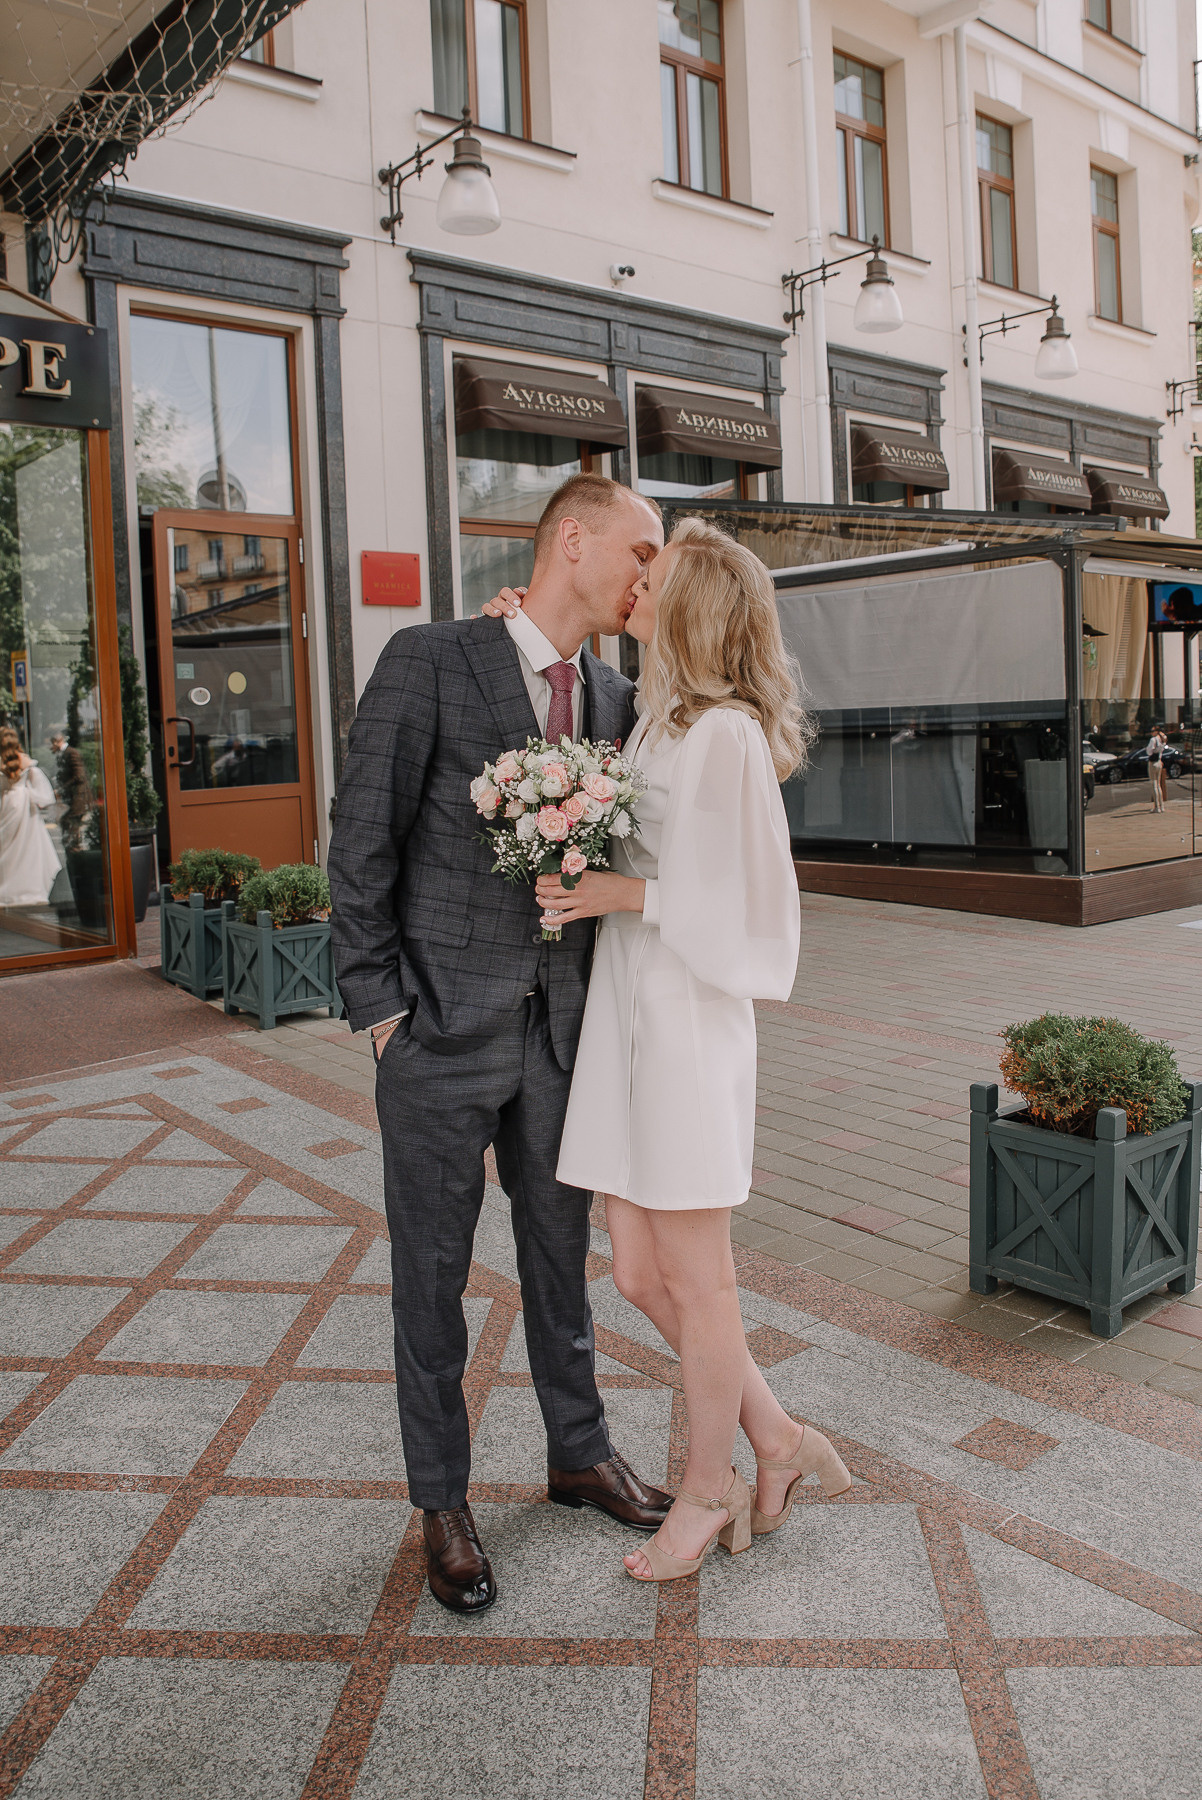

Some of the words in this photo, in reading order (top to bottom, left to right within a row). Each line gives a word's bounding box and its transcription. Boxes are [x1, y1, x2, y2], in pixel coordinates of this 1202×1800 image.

[502, 382, 606, 414] AVIGNON
[676, 408, 769, 438] АВИНЬОН
[879, 442, 945, 465] AVIGNON
[1117, 485, 1162, 502] AVIGNON
